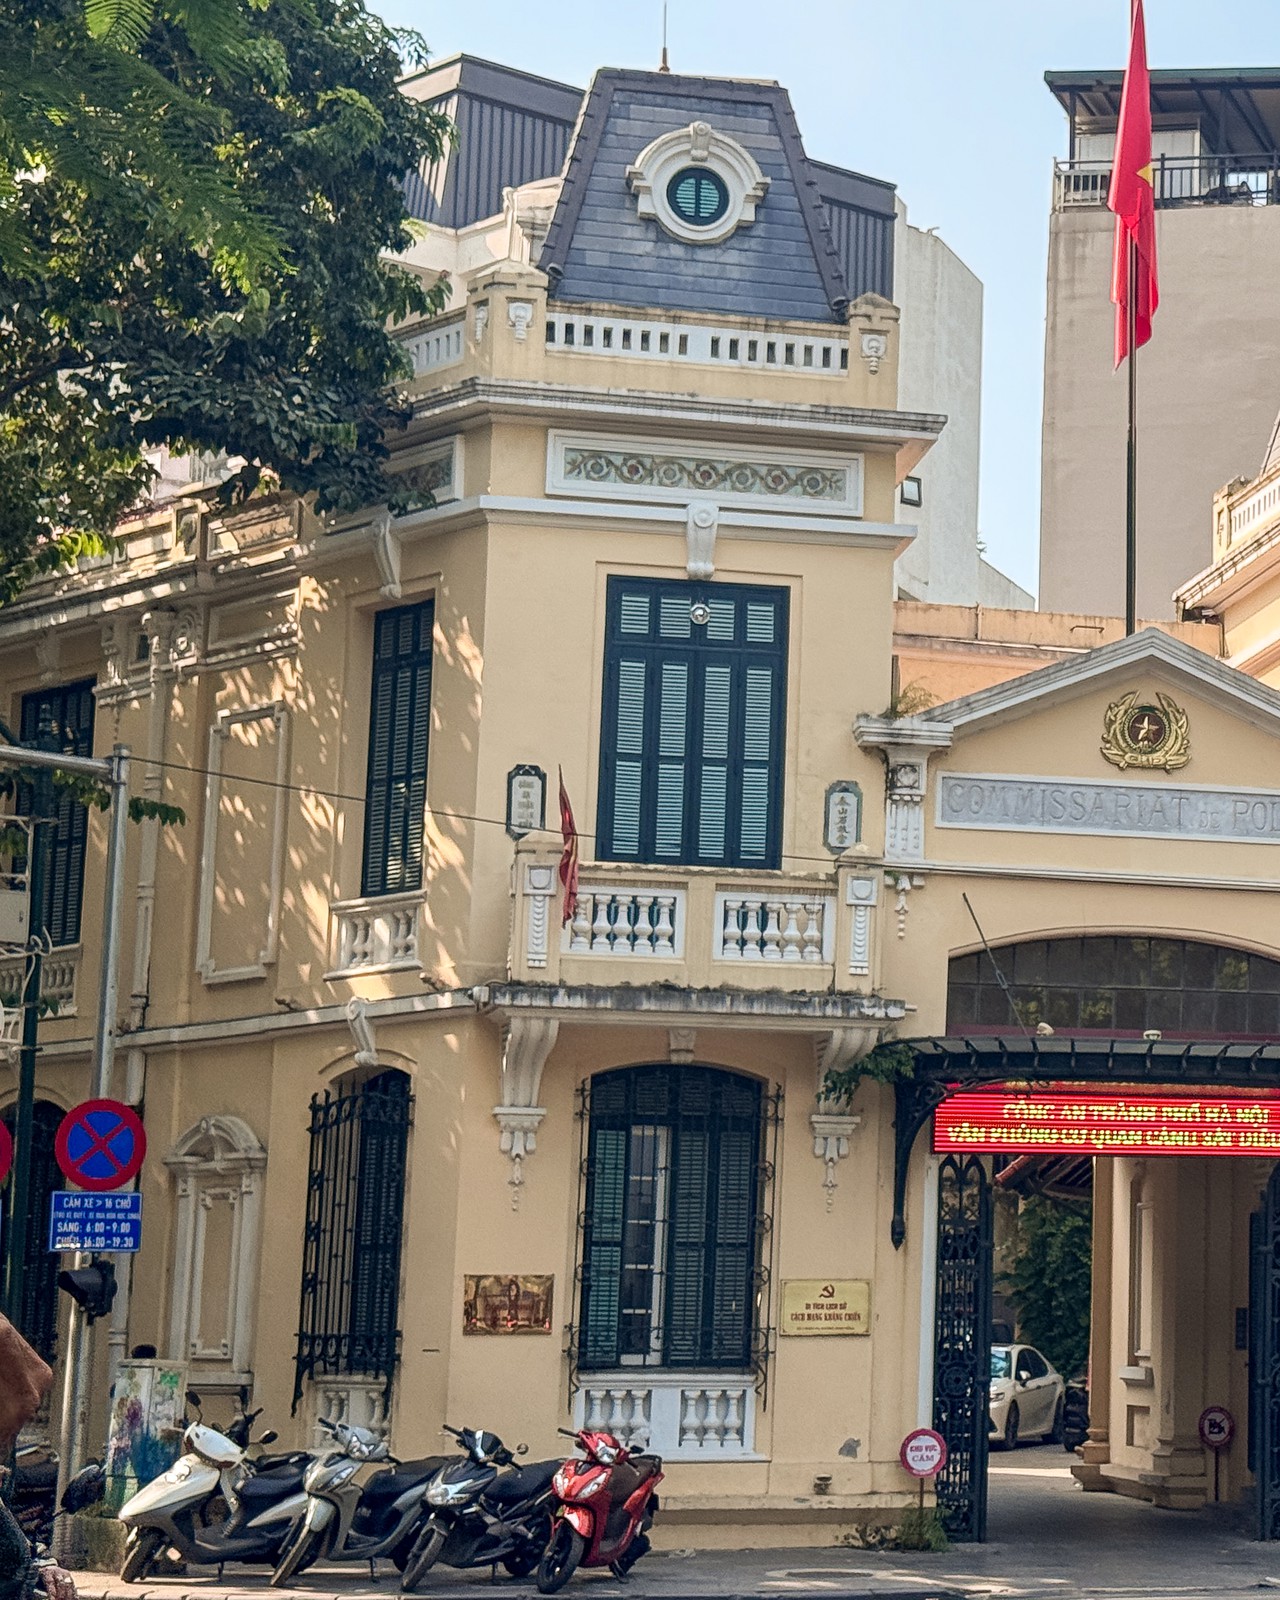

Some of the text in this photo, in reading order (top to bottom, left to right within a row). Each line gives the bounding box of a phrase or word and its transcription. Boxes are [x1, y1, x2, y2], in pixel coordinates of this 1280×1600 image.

[948, 783, 1189, 828] COMMISSARIAT
[1060, 1105, 1086, 1120] AN
[1205, 1104, 1232, 1123] HÀ
[1236, 1104, 1270, 1127] NỘI
[84, 1197, 94, 1208] XE
[105, 1198, 112, 1209] 16
[57, 1220, 82, 1233] SÁNG:
